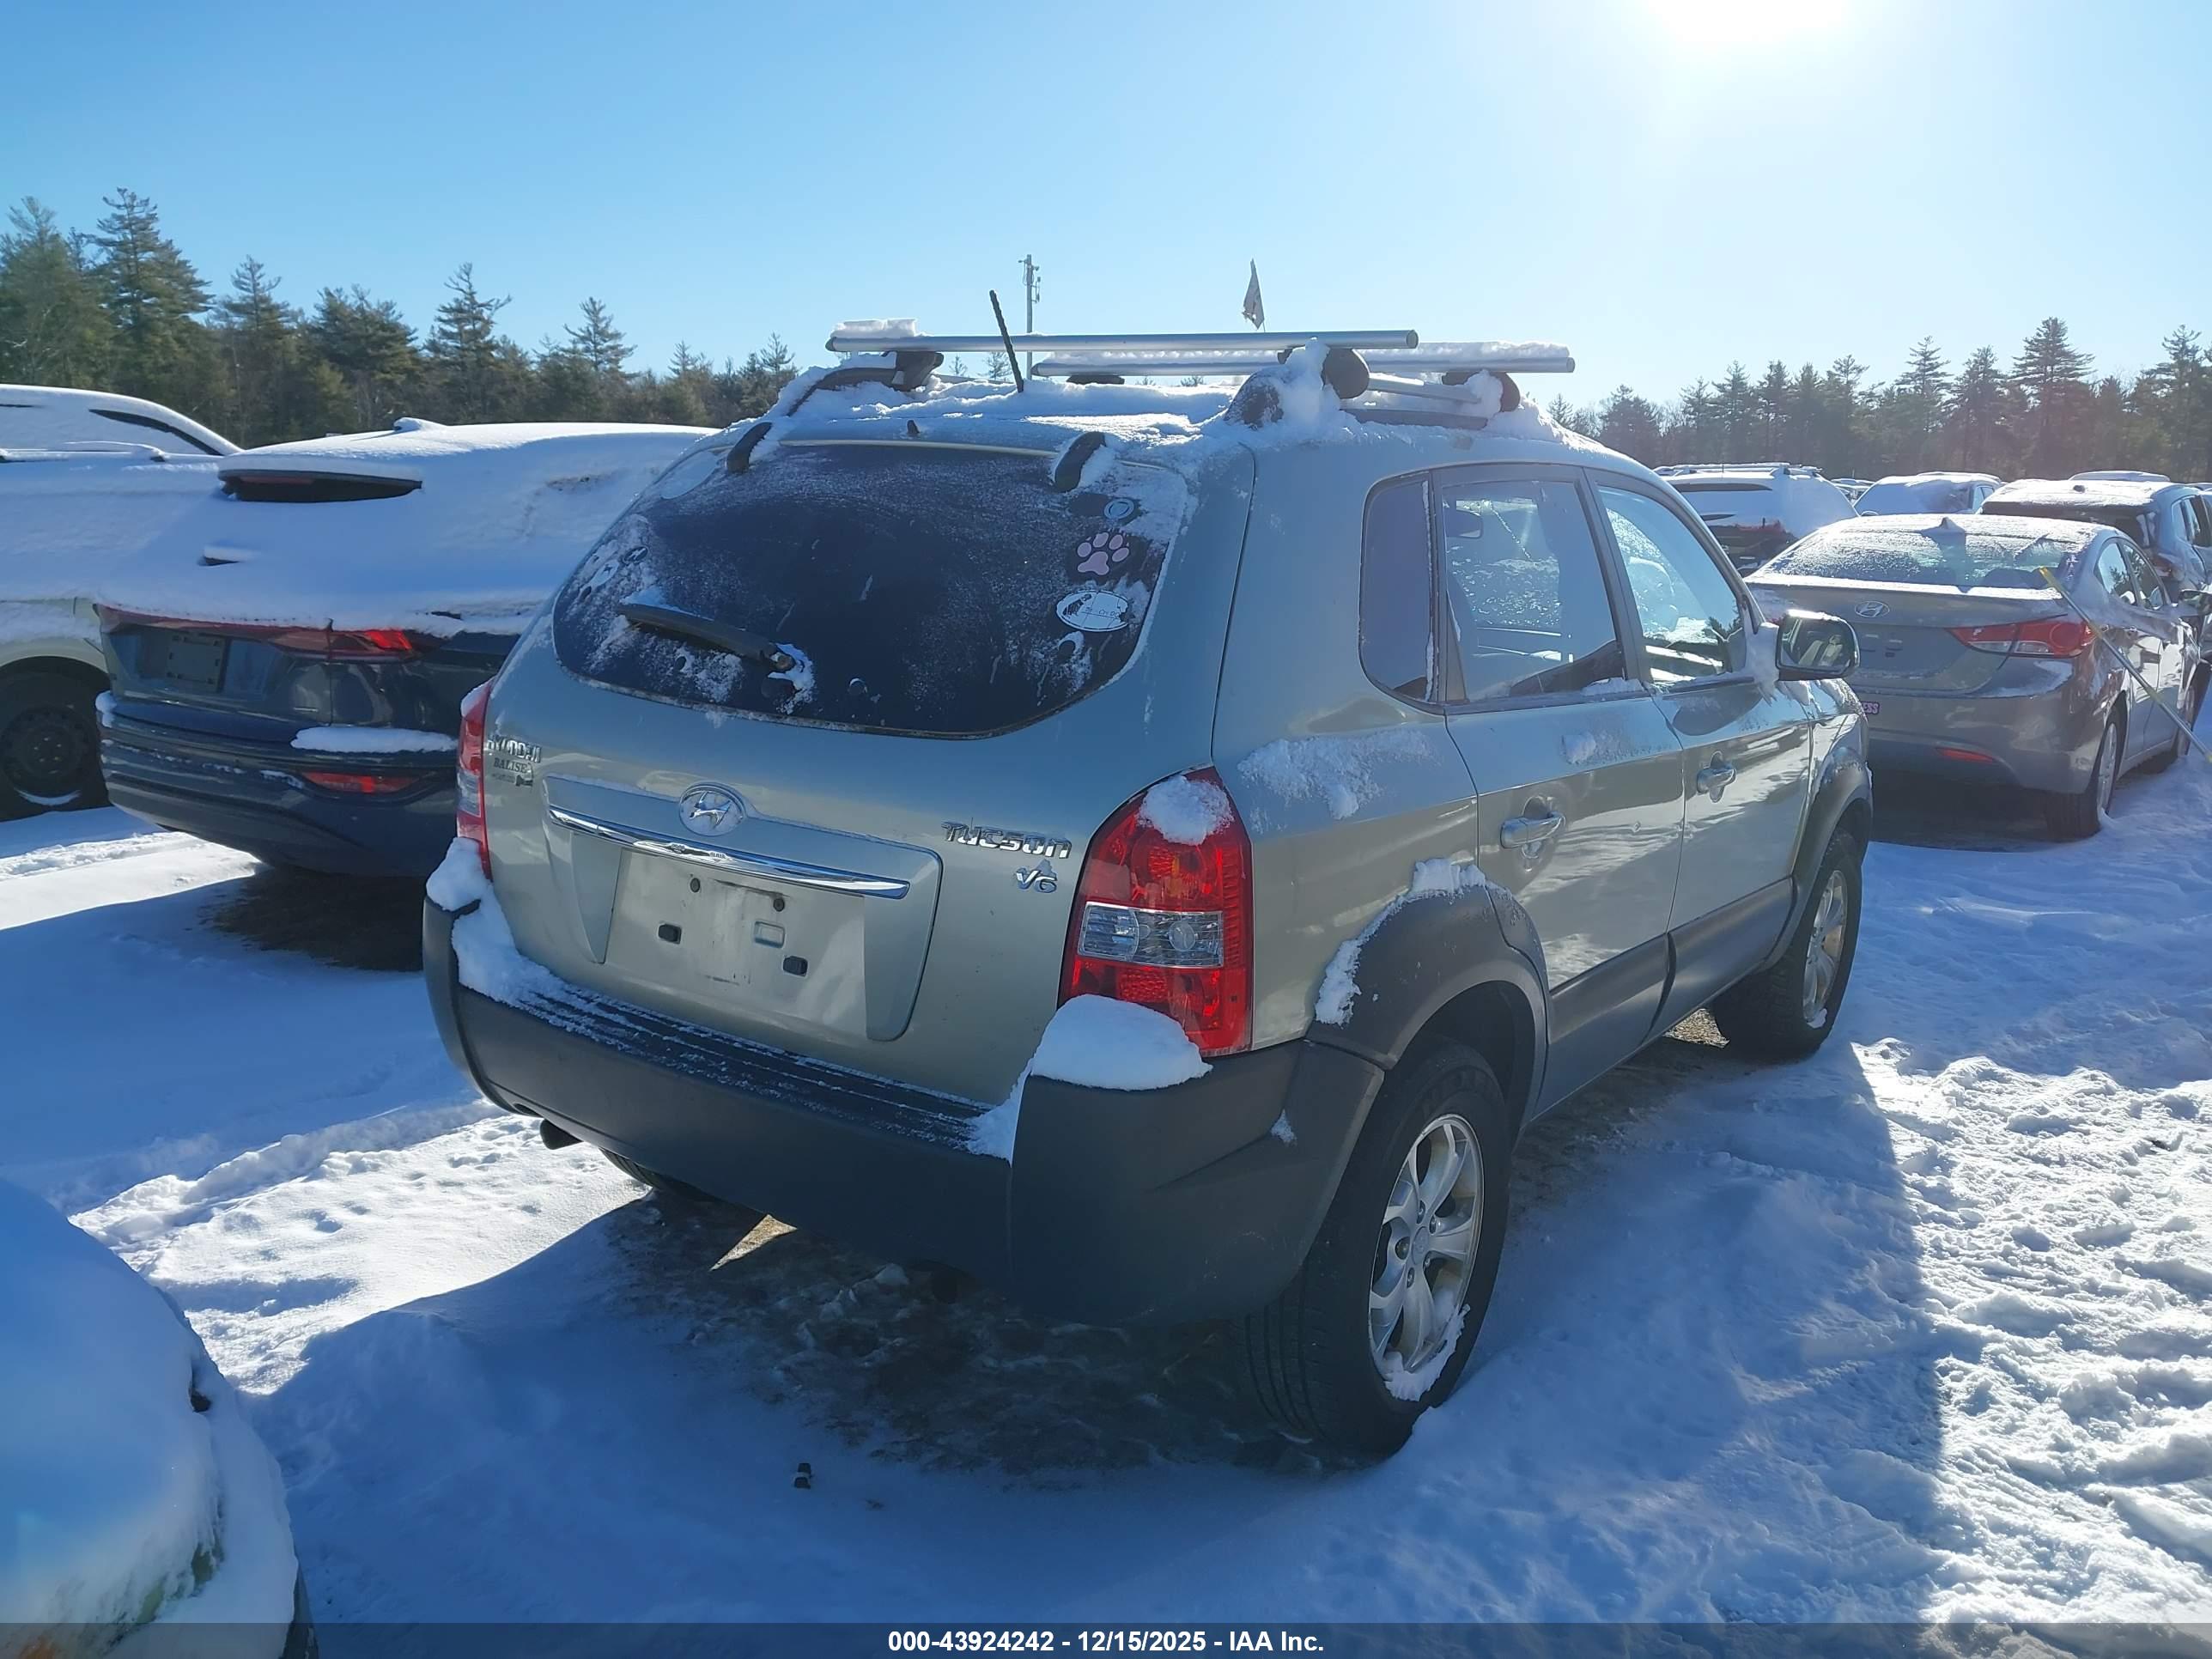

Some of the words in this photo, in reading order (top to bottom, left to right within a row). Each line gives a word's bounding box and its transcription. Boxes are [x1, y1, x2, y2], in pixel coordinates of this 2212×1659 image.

[494, 757, 528, 774] BALISE
[942, 822, 1072, 859] TUCSON
[1016, 867, 1058, 894] V6
